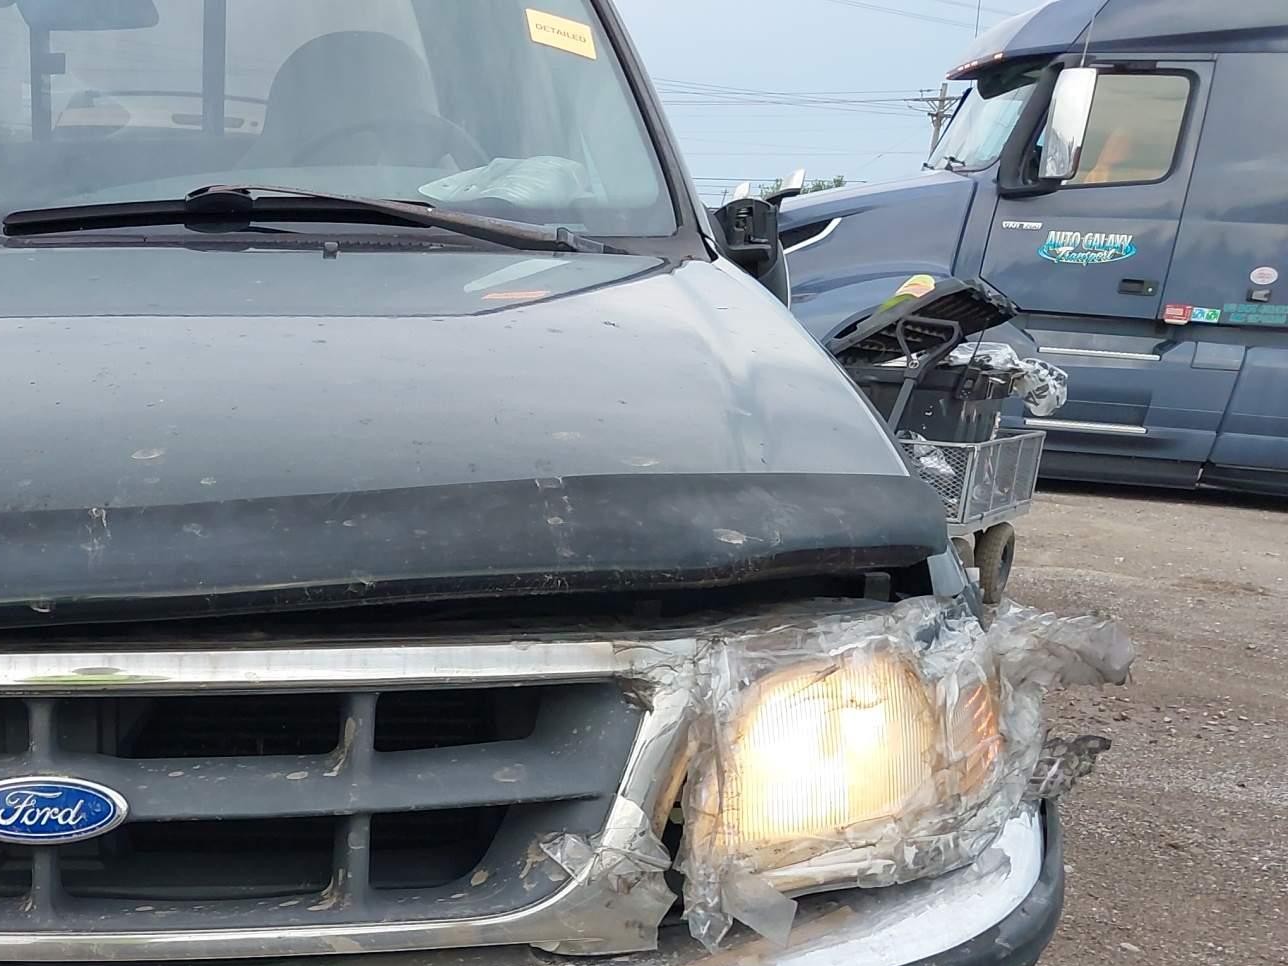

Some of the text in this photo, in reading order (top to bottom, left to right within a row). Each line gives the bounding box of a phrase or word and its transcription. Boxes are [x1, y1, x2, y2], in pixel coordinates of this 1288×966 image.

[535, 23, 587, 43] DETAILED
[1046, 230, 1133, 255] AUTO GALAXY
[1055, 246, 1116, 266] Transport
